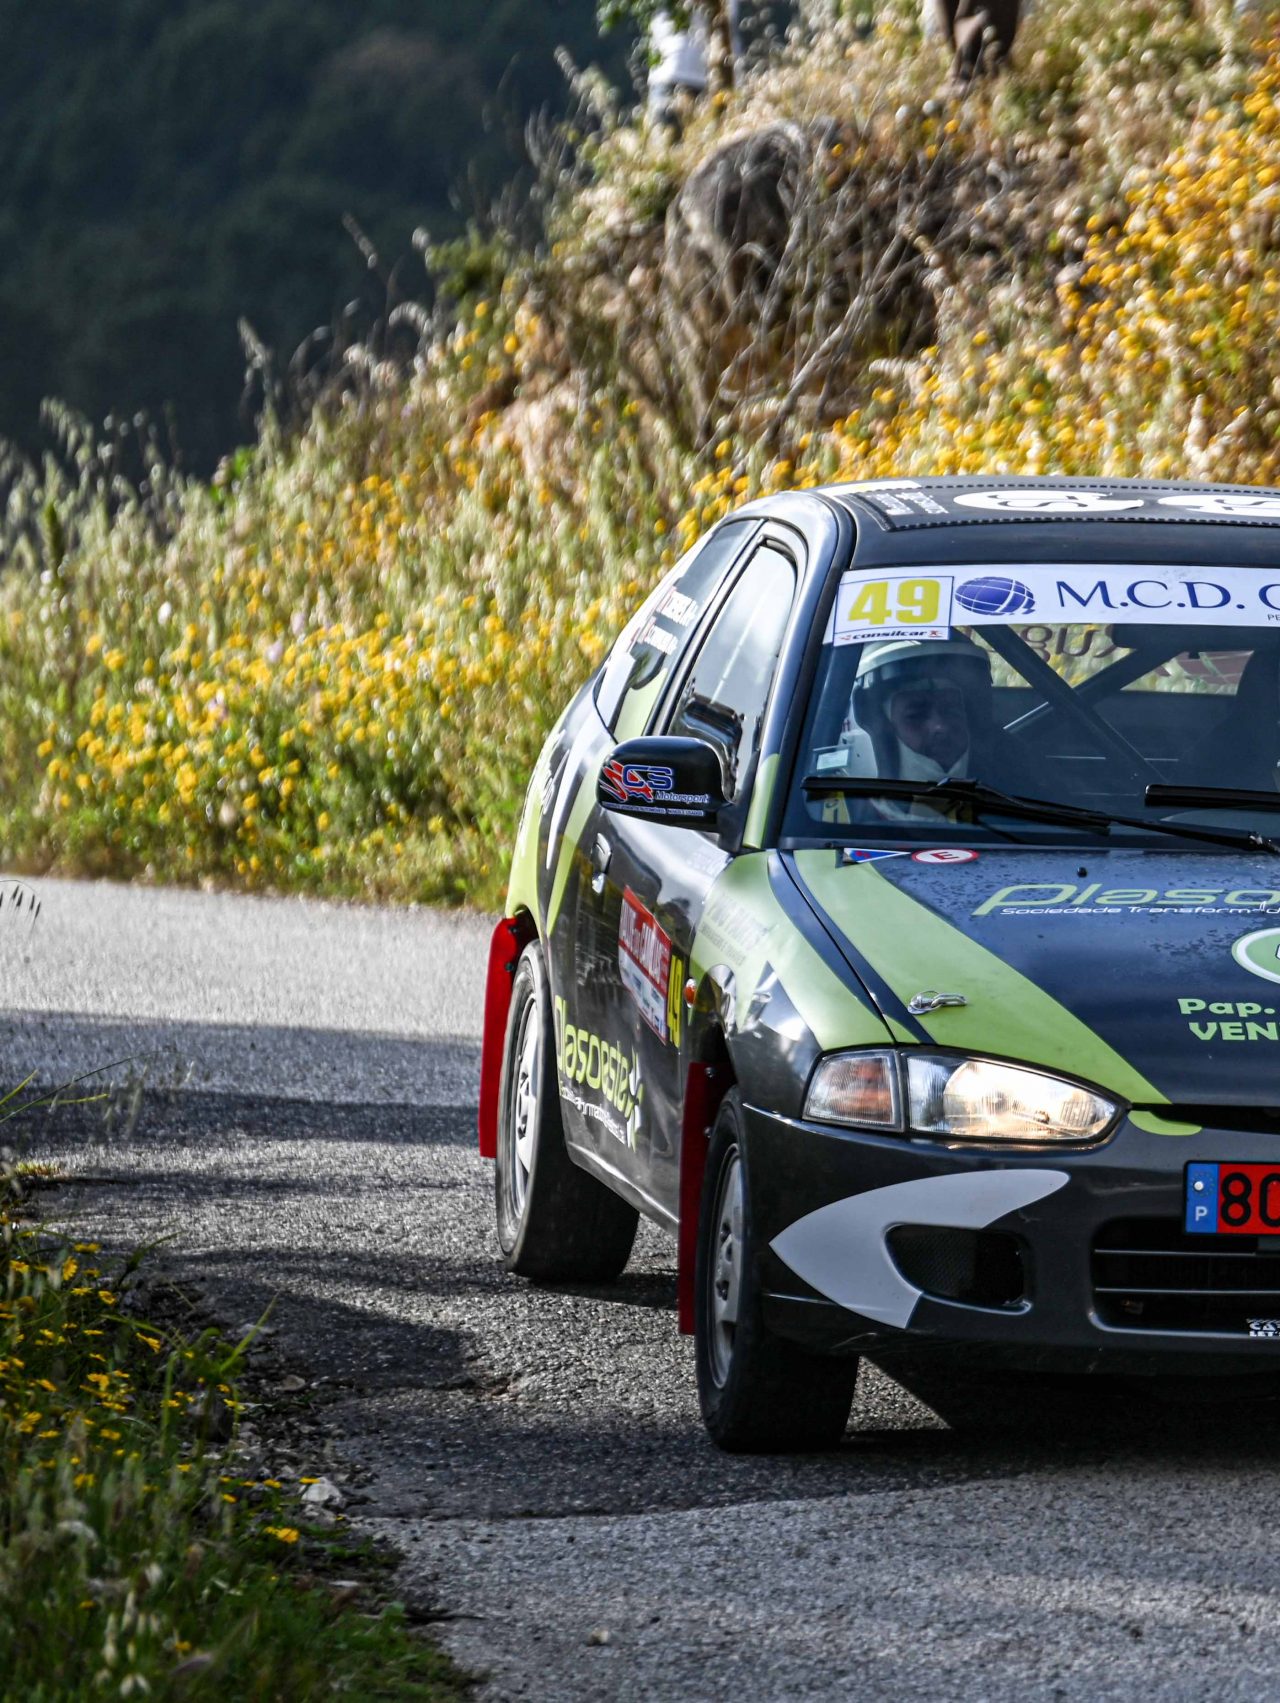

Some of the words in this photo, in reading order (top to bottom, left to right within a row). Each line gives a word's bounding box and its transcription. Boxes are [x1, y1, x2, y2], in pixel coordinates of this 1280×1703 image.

[847, 578, 941, 625] 49
[1056, 579, 1245, 610] M.C.D.
[852, 630, 927, 640] consilcar
[655, 791, 709, 804] Motorsport
[1000, 906, 1122, 915] Sociedade
[1177, 998, 1275, 1018] Pap.
[1195, 1206, 1207, 1222] P
